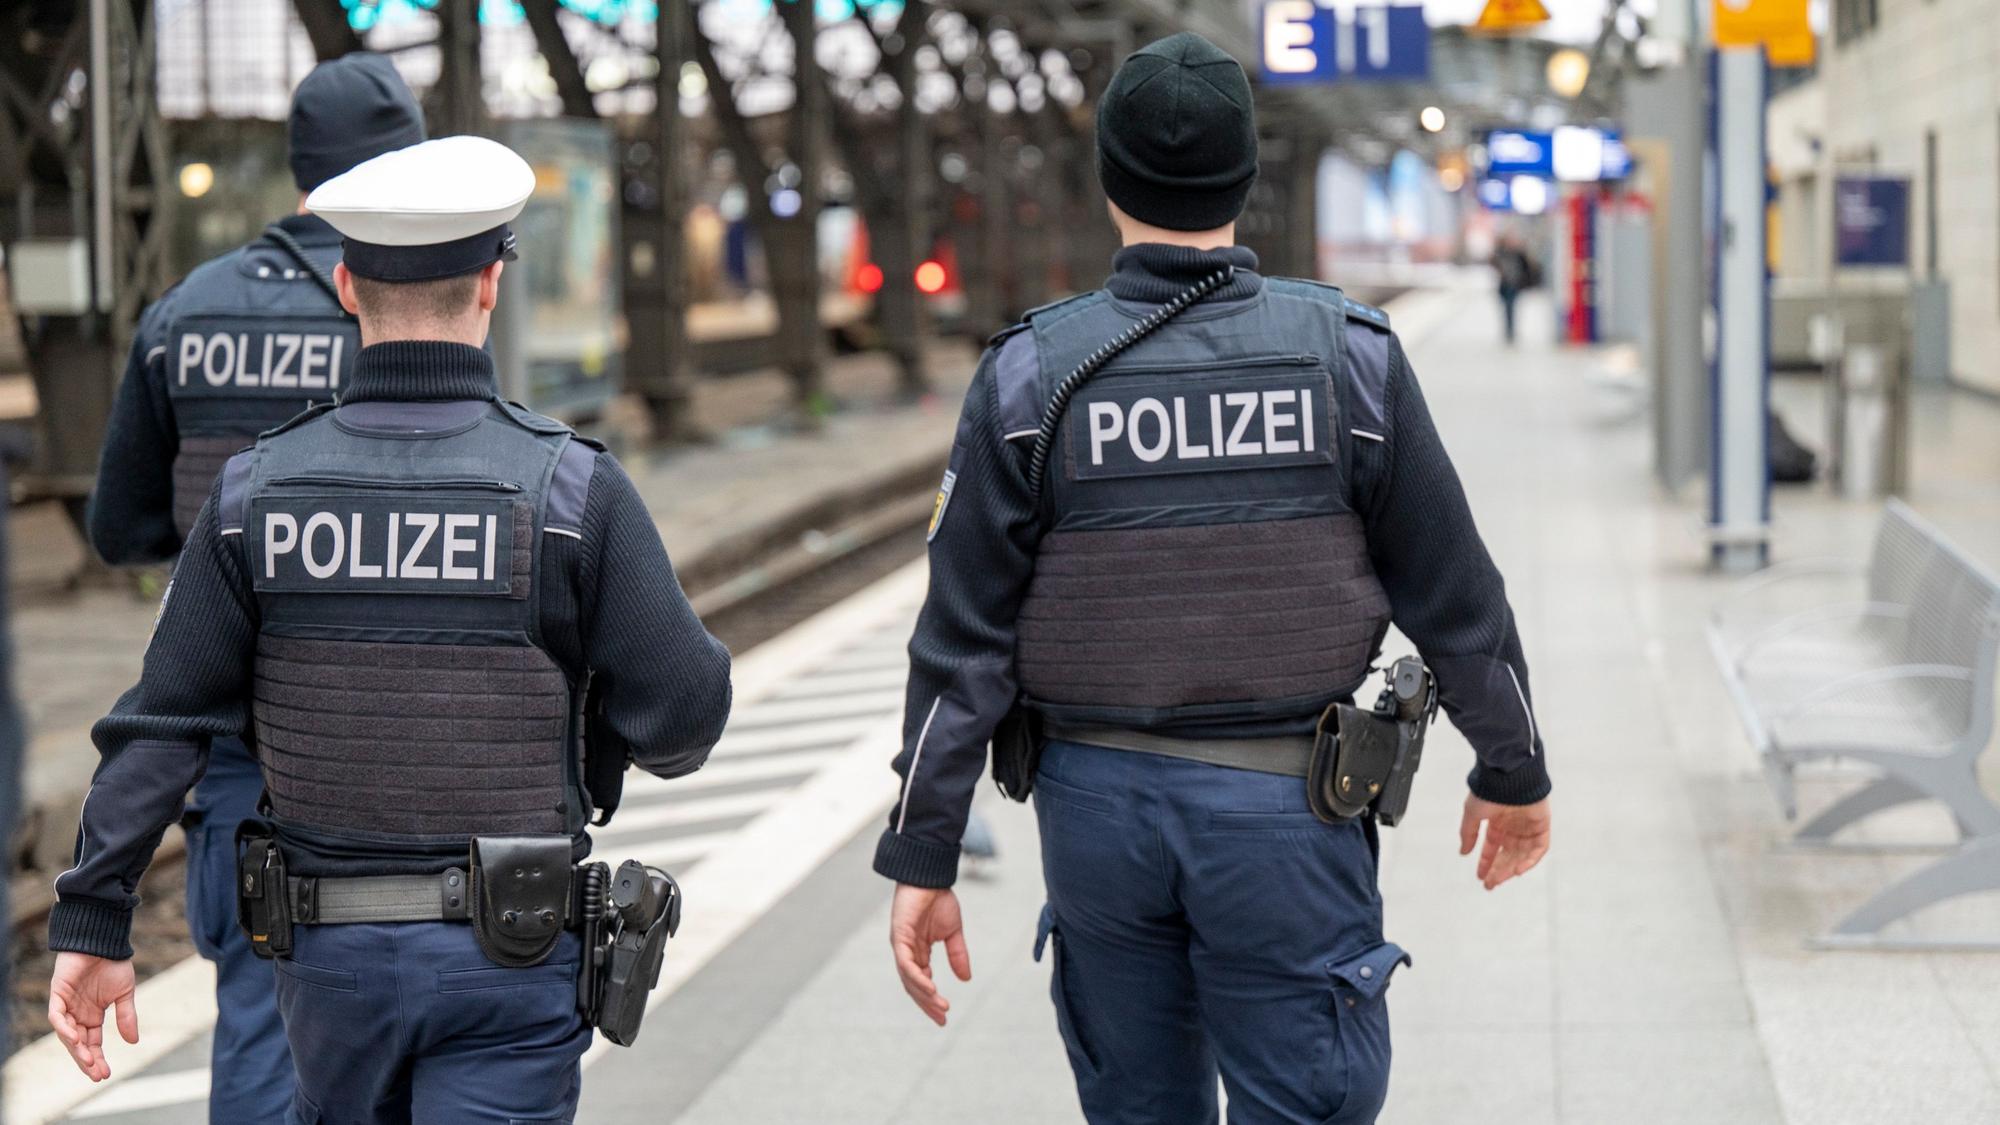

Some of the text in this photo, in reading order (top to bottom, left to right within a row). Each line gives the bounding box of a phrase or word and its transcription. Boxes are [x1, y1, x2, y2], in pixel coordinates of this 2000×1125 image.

[1263, 0, 1317, 73] E
[178, 333, 343, 388] POLIZEI
[1088, 389, 1315, 465] POLIZEI
[264, 511, 497, 580] POLIZEI
